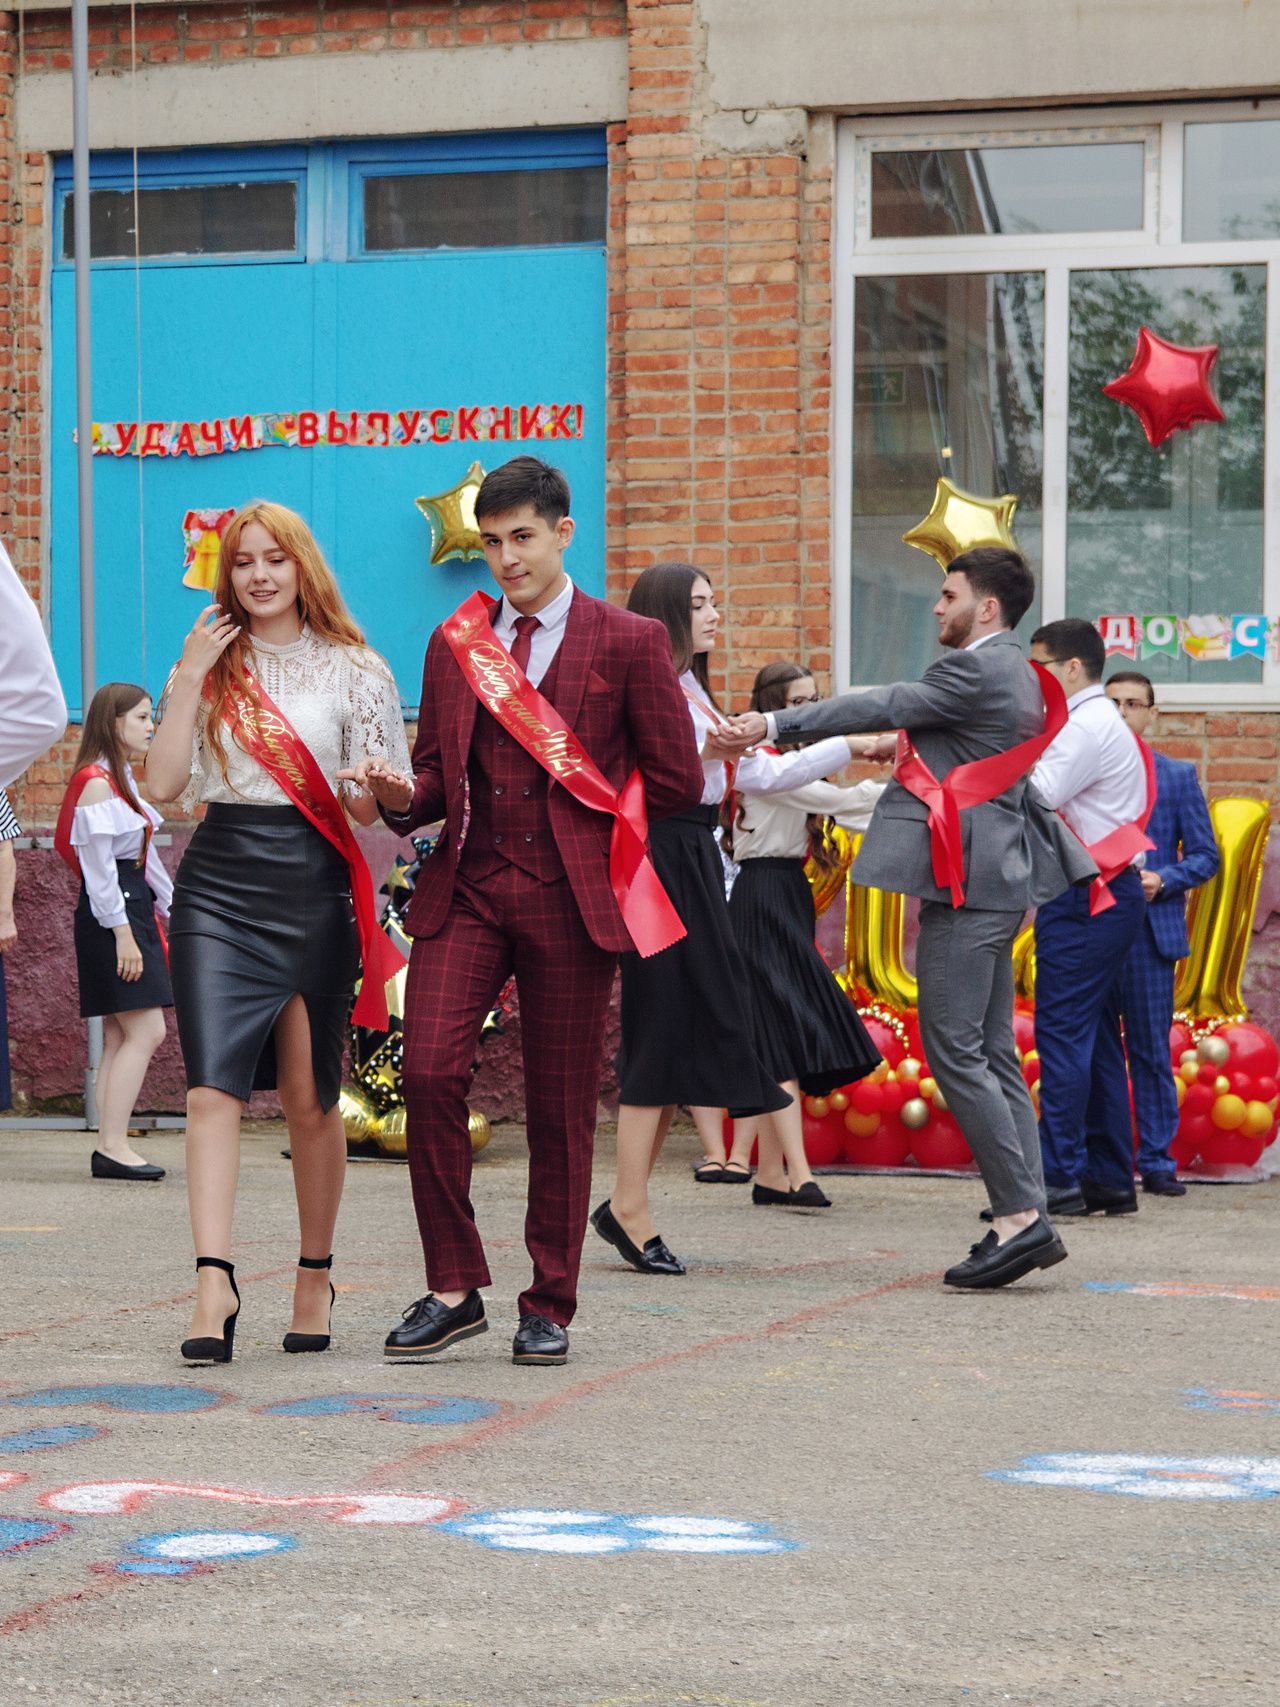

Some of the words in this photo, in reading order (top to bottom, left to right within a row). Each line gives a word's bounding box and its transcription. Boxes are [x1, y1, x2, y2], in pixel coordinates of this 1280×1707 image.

[297, 404, 583, 447] ВЫПУСКНИК!
[1105, 617, 1175, 650] ДО
[466, 639, 551, 735] Выпускник
[529, 730, 592, 777] 2021
